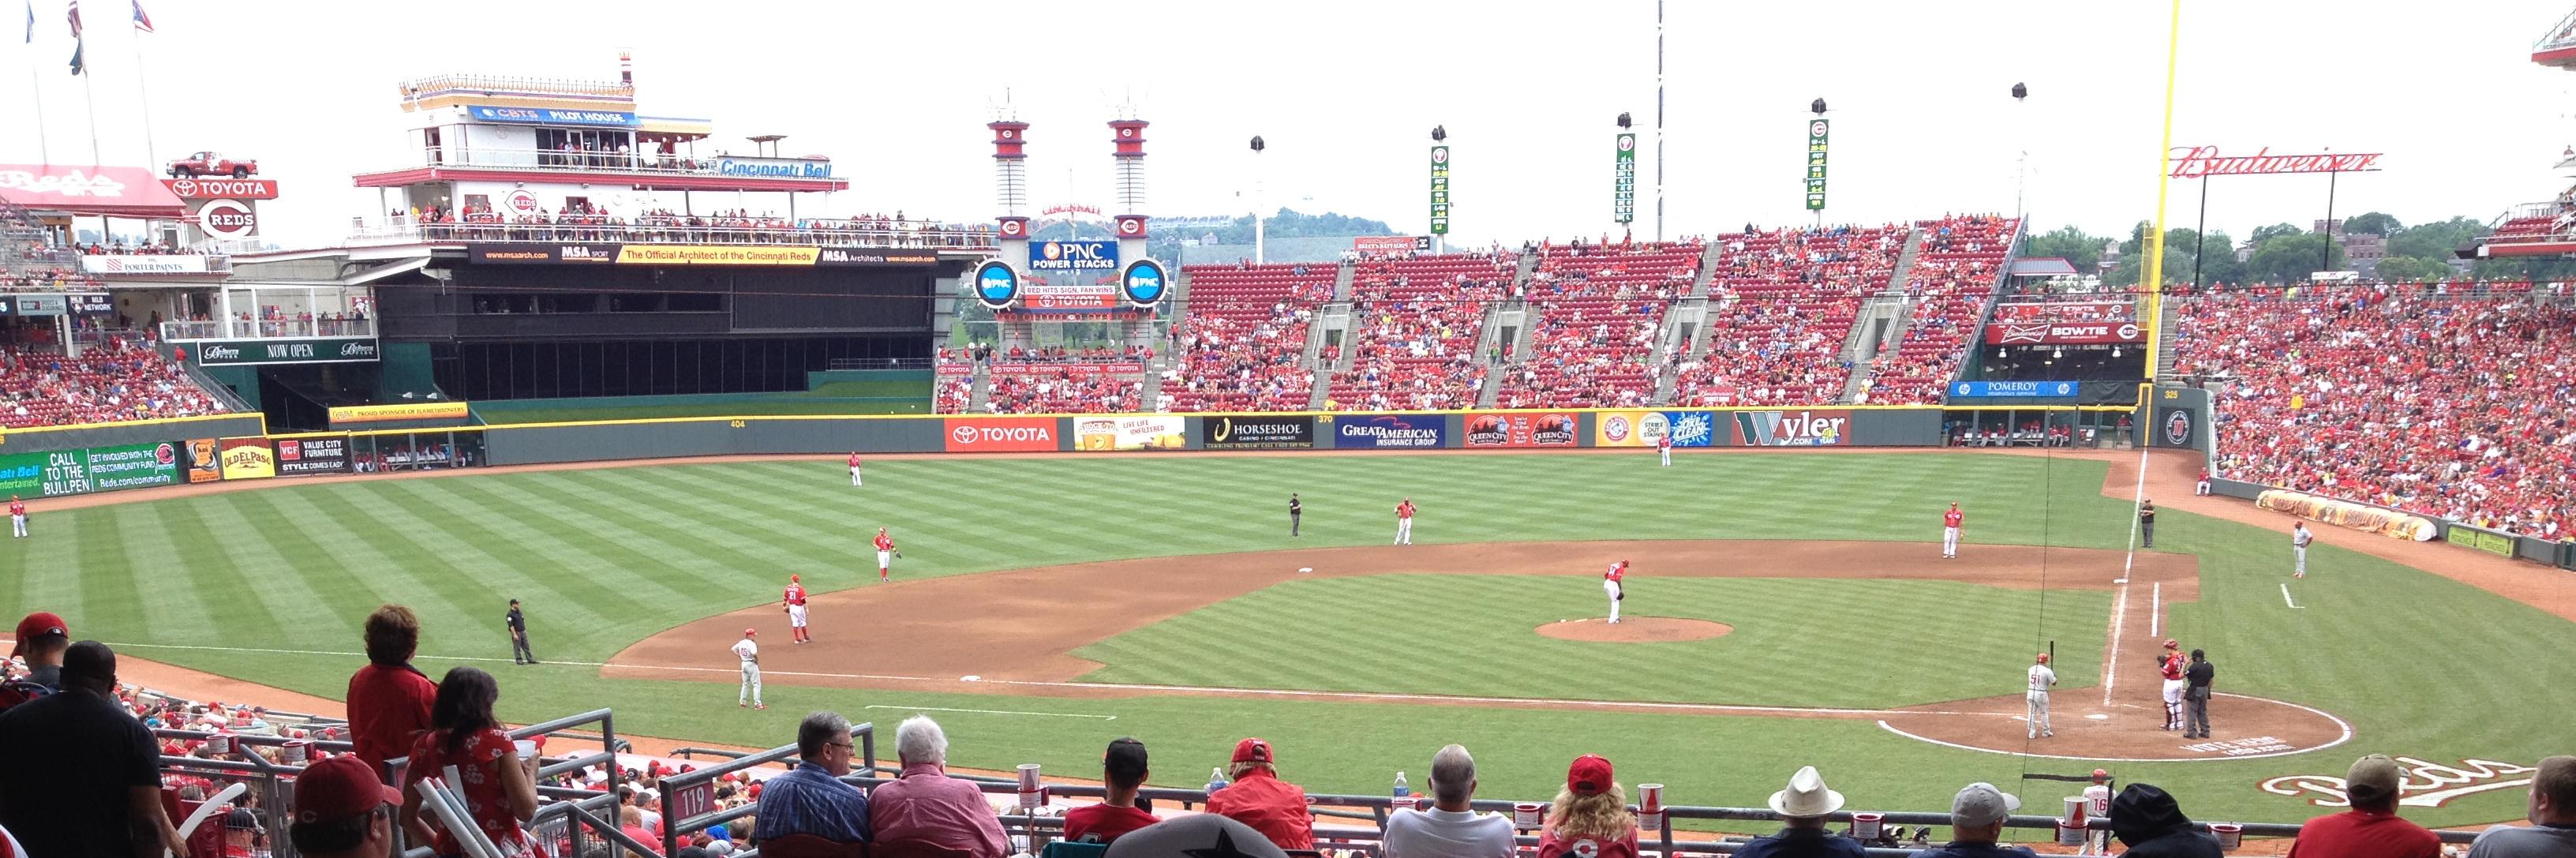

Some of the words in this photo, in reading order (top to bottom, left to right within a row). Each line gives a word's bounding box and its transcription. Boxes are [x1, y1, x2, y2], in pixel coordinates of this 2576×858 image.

[497, 109, 538, 118] CBTS
[549, 111, 582, 120] PILOT
[583, 112, 626, 122] HOUSE
[2170, 145, 2379, 178] Budweiser
[721, 159, 799, 176] Cincinnati
[803, 162, 832, 178] Bell
[200, 182, 267, 195] TOYOTA
[211, 215, 254, 226] REDS
[561, 246, 590, 257] MSA
[626, 250, 642, 259] The
[646, 250, 676, 260] Official
[679, 251, 718, 260] Architect
[720, 251, 729, 260] of
[731, 251, 744, 260] the
[747, 251, 788, 260] Cincinnati
[790, 252, 811, 260] Reds
[822, 250, 848, 261] MSA
[1061, 244, 1103, 260] PNC
[1033, 260, 1071, 268] POWER
[1073, 259, 1114, 268] STACKS
[991, 279, 1012, 288] PNC
[1140, 278, 1159, 287] PNC
[1057, 295, 1103, 306] TOYOTA
[2052, 327, 2108, 335] BOWTIE
[268, 344, 288, 358] NOW
[290, 343, 313, 357] OPEN
[1988, 382, 2039, 391] POMEROY
[1683, 417, 1700, 428] OXI
[1734, 410, 1845, 445] Wyler
[981, 427, 1050, 441] TOYOTA
[1234, 424, 1302, 435] HORSESHOE
[1342, 424, 1383, 436] GREAT
[1377, 427, 1437, 439] AMERICAN
[1674, 422, 1706, 440] CLEAN
[1470, 433, 1492, 441] QUEEN
[1492, 432, 1507, 440] CITY
[1533, 432, 1556, 441] QUEEN
[1556, 431, 1573, 440] CITY
[282, 446, 298, 455] VCF
[303, 440, 324, 449] VALUE
[50, 452, 77, 466] CALL
[103, 452, 128, 461] INVOLVED
[224, 455, 240, 467] OLD
[239, 451, 249, 461] EL
[305, 448, 343, 458] FURNITURE
[17, 465, 39, 477] Bell
[45, 467, 61, 481] TO
[62, 466, 84, 479] THE
[107, 463, 140, 472] COMMUNITY
[43, 478, 90, 495] BULLPEN
[100, 474, 170, 488] Reds.com/community
[789, 591, 796, 600] 21
[2031, 674, 2040, 684] 51
[682, 786, 705, 816] 119
[2094, 798, 2107, 811] 16
